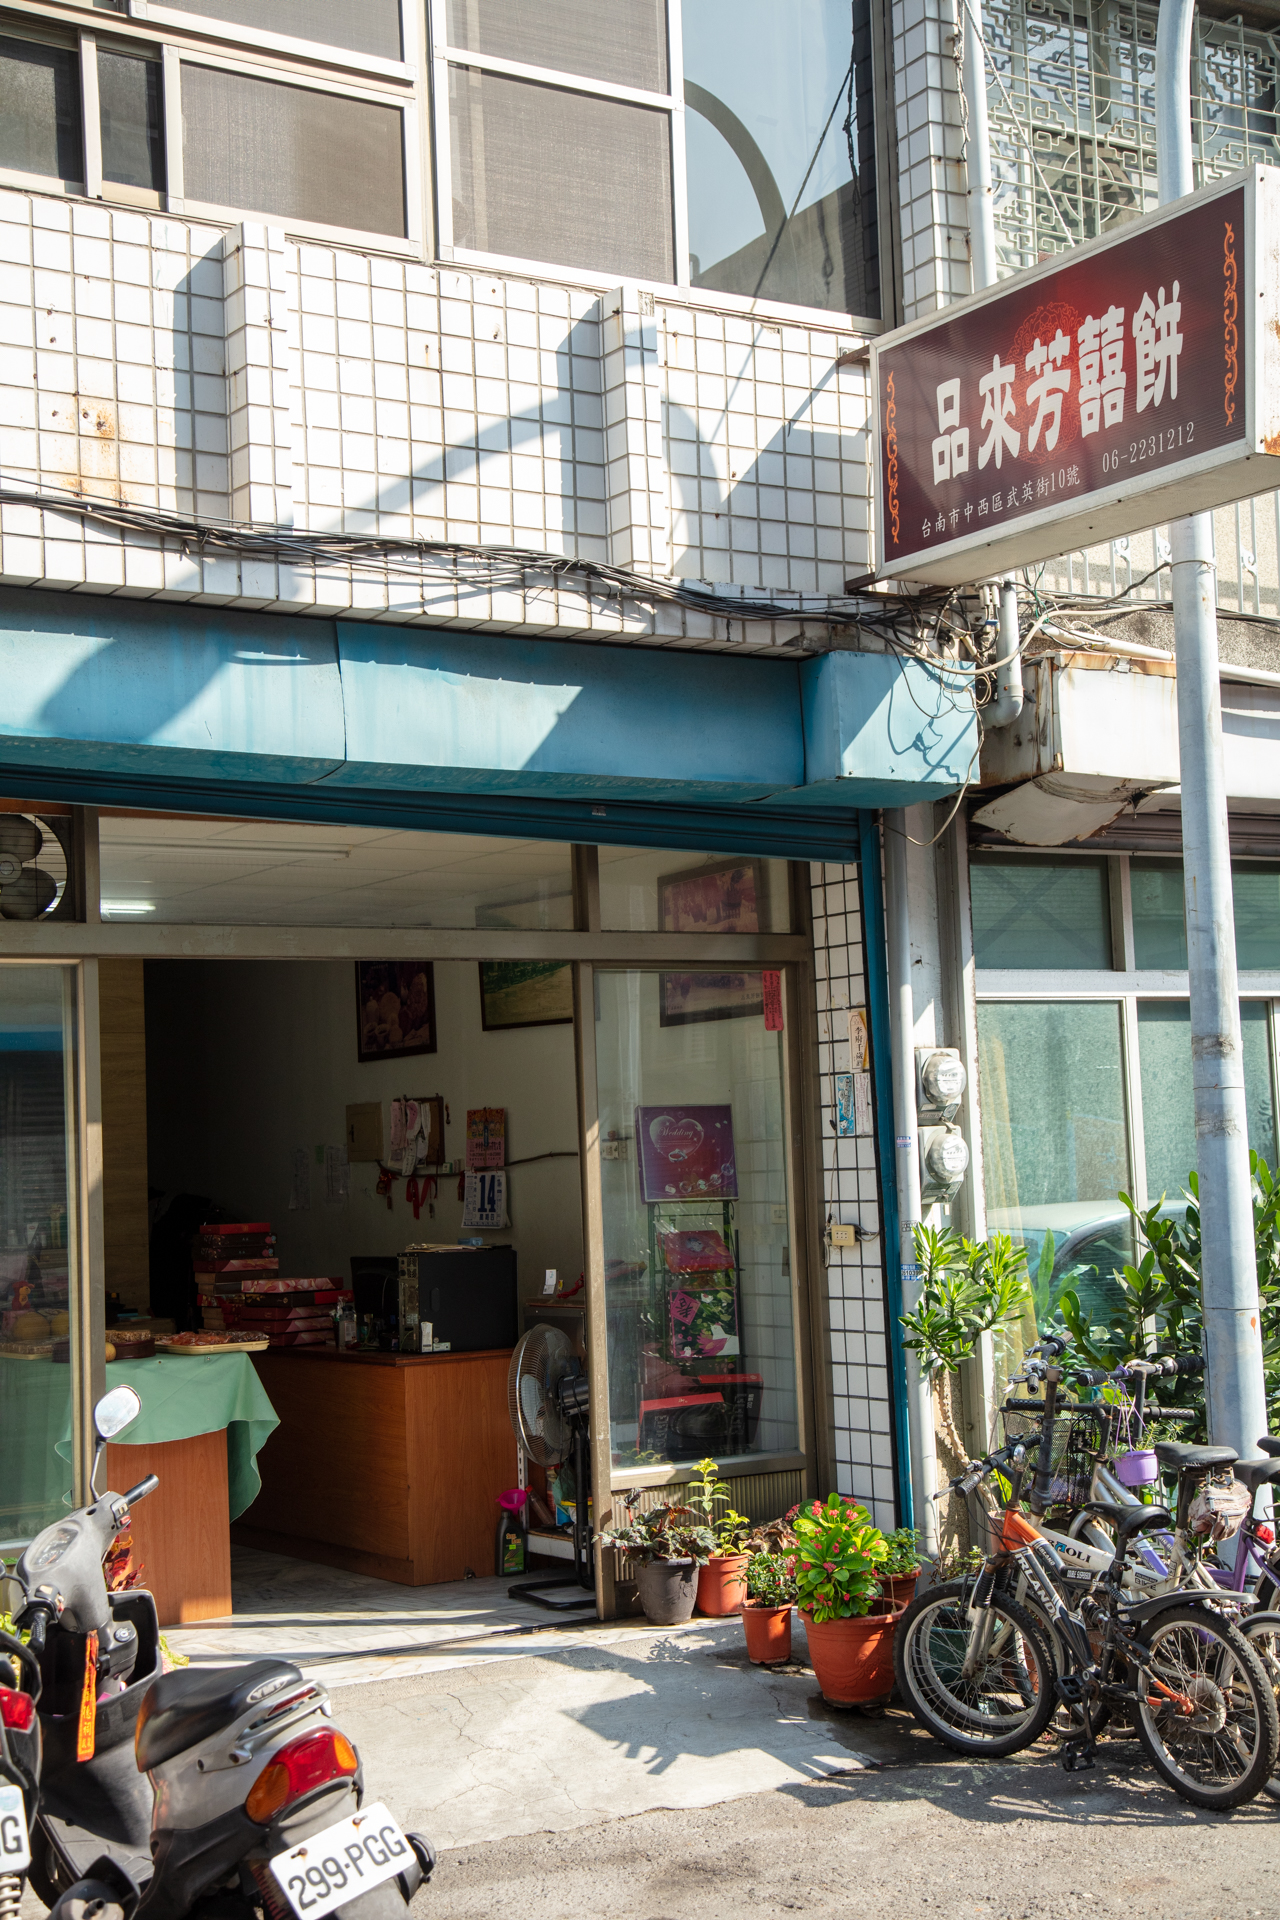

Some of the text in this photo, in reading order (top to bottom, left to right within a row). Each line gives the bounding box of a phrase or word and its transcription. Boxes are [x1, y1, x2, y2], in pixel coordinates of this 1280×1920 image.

[931, 280, 1184, 486] 品來芳囍餅
[921, 421, 1195, 539] 台南市中西區武英街10號 06-2231212
[657, 1126, 694, 1144] Wedding
[478, 1174, 496, 1212] 14
[674, 1297, 693, 1318] 春
[1015, 1553, 1056, 1614] IRLAND
[0, 1815, 23, 1855] G
